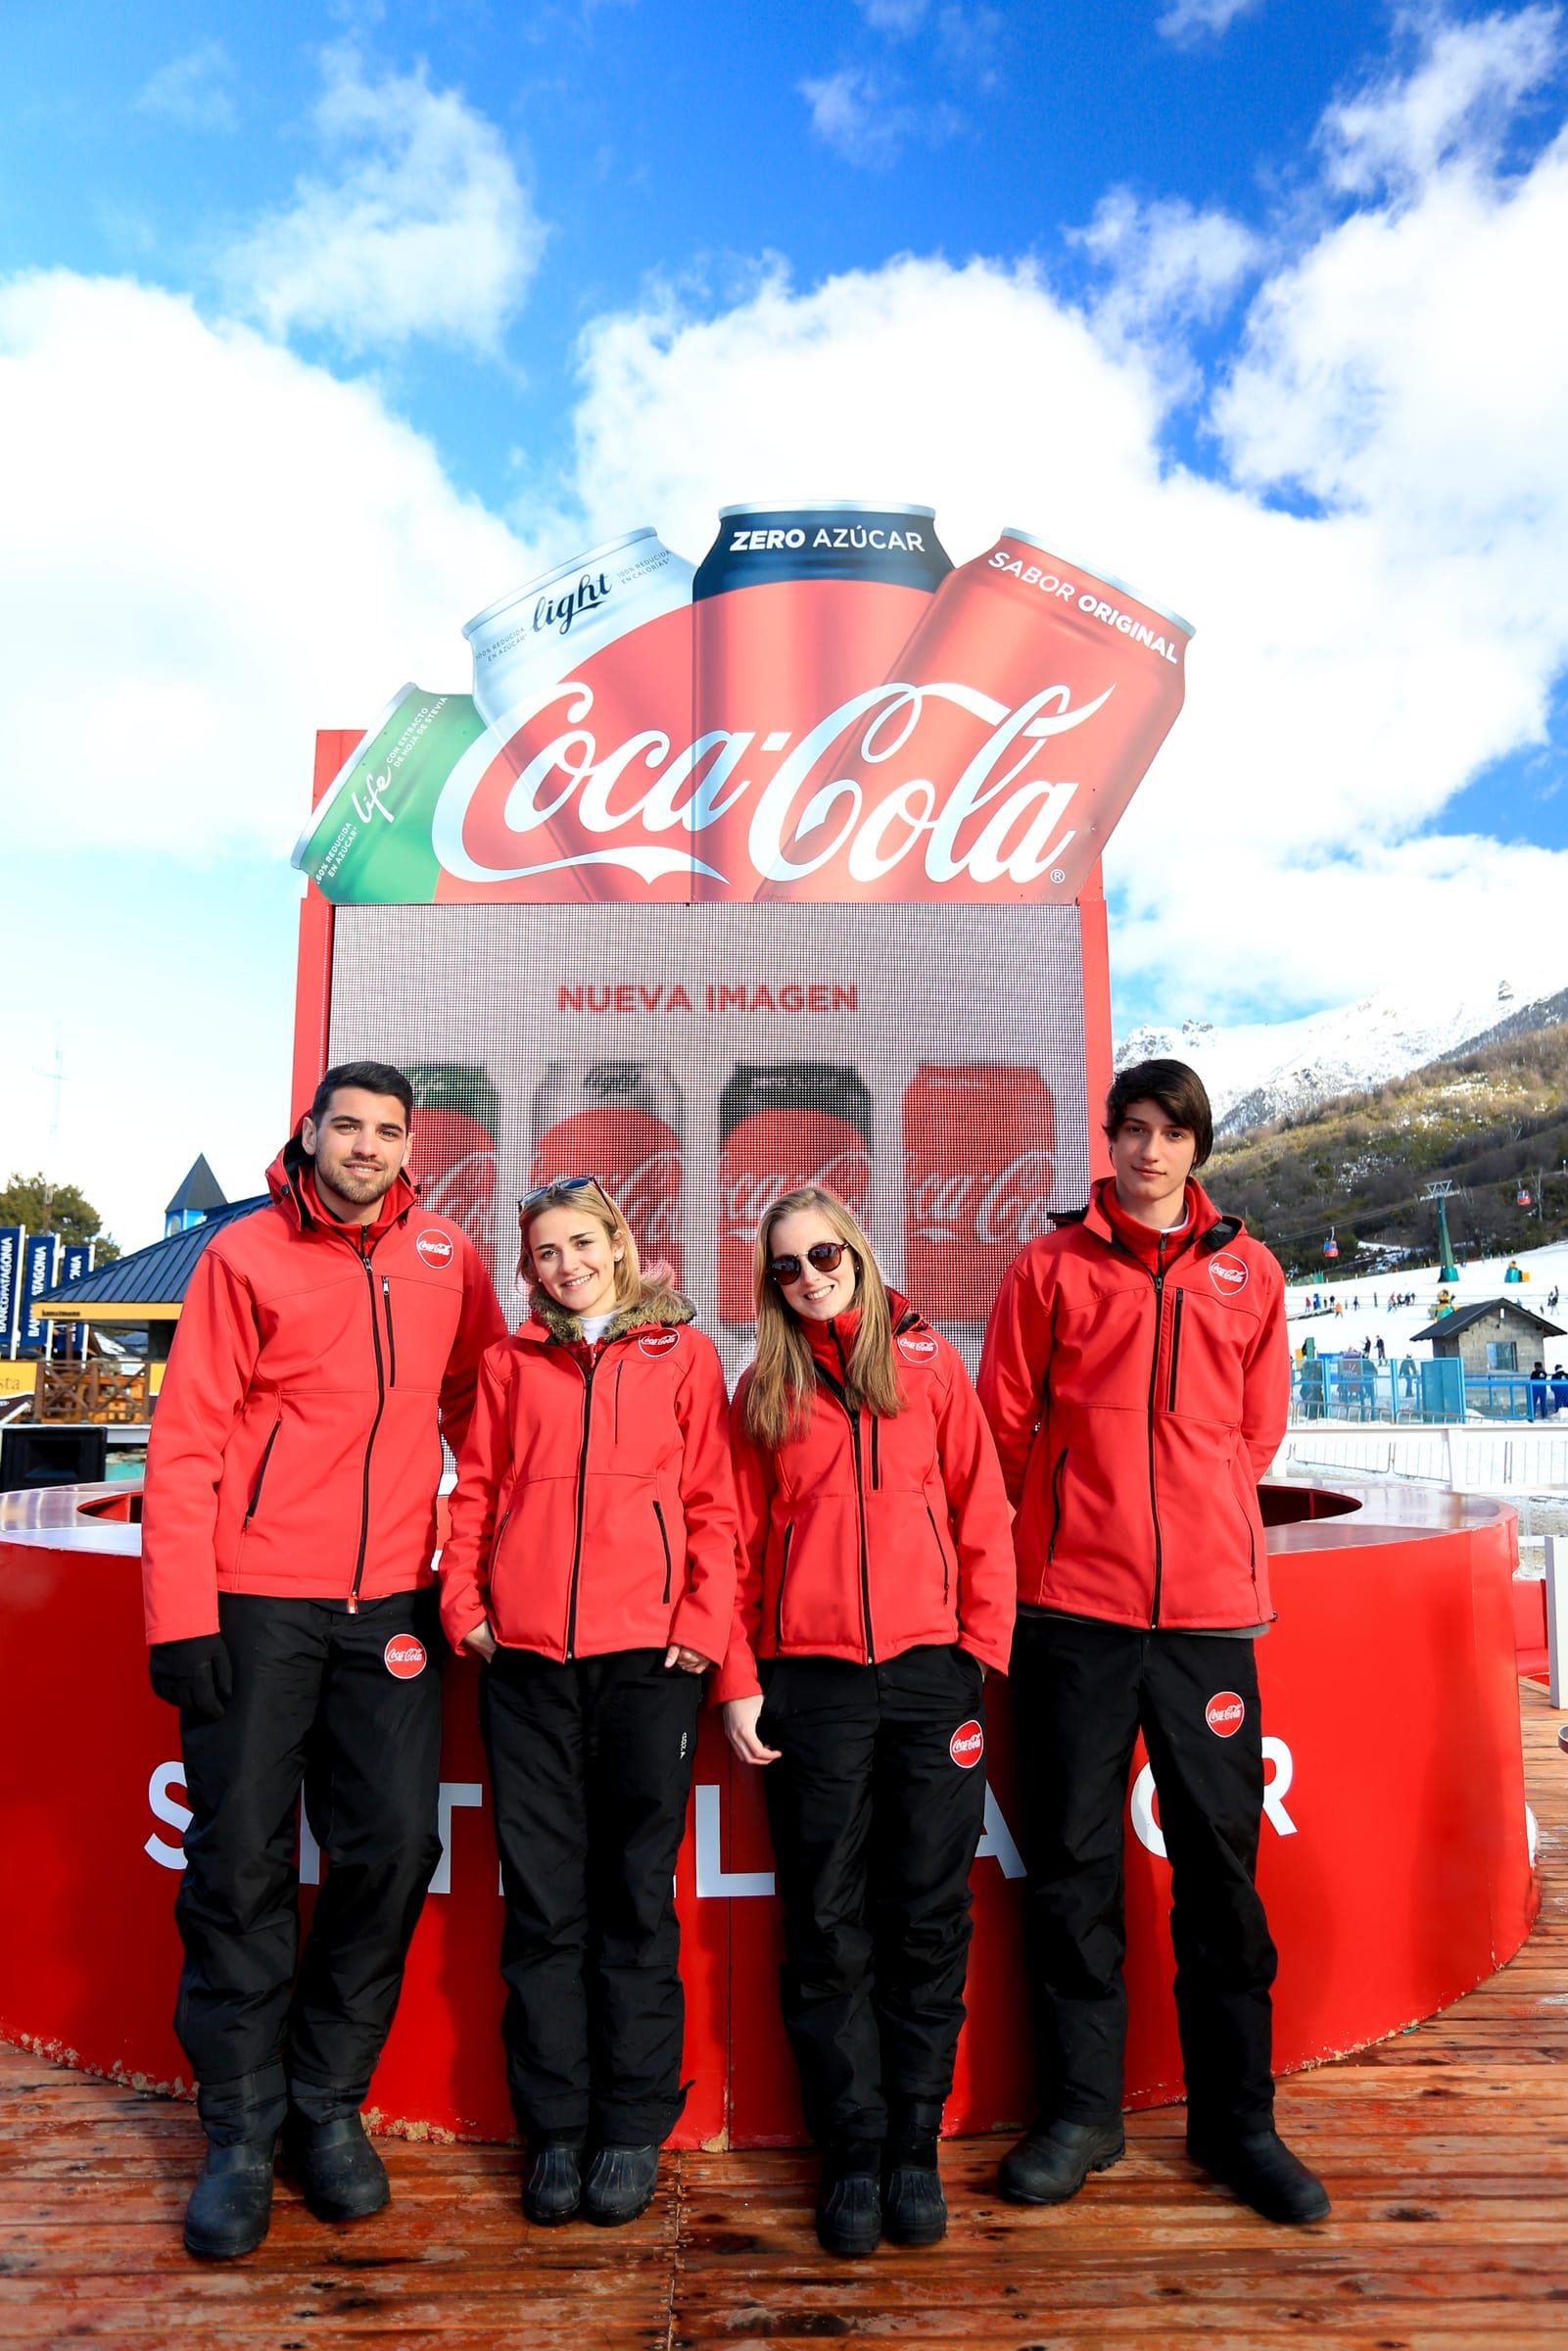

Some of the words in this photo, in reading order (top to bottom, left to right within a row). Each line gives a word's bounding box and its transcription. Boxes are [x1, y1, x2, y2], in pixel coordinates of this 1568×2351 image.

[729, 528, 806, 552] ZERO
[812, 524, 926, 552] AZÚCAR
[531, 571, 613, 636] light
[987, 550, 1075, 603] SABOR
[1076, 594, 1180, 665] ORIGINAL
[492, 626, 525, 649] REDUCIDA
[386, 746, 402, 764] CON
[398, 705, 429, 747] EXTRACTO
[393, 756, 404, 769] DE
[403, 734, 420, 757] HOJA
[415, 721, 429, 737] DE
[425, 696, 449, 725] STEVIA
[350, 765, 394, 825] life
[431, 681, 1117, 886] Coca-Cola
[324, 822, 354, 864] REDUCIDA
[327, 864, 338, 879] EN
[557, 984, 692, 1013] NUEVA
[705, 984, 858, 1013] IMAGEN
[418, 1239, 453, 1256] Coca-Cola
[1210, 1262, 1247, 1283] Coca-Cola
[641, 1332, 677, 1346] Coca-Cola
[899, 1338, 934, 1353] Coca-Cola
[386, 1648, 424, 1662] Coca-Cola
[1209, 1703, 1242, 1723] Coca-Cola
[952, 1733, 982, 1753] Coca-Cola
